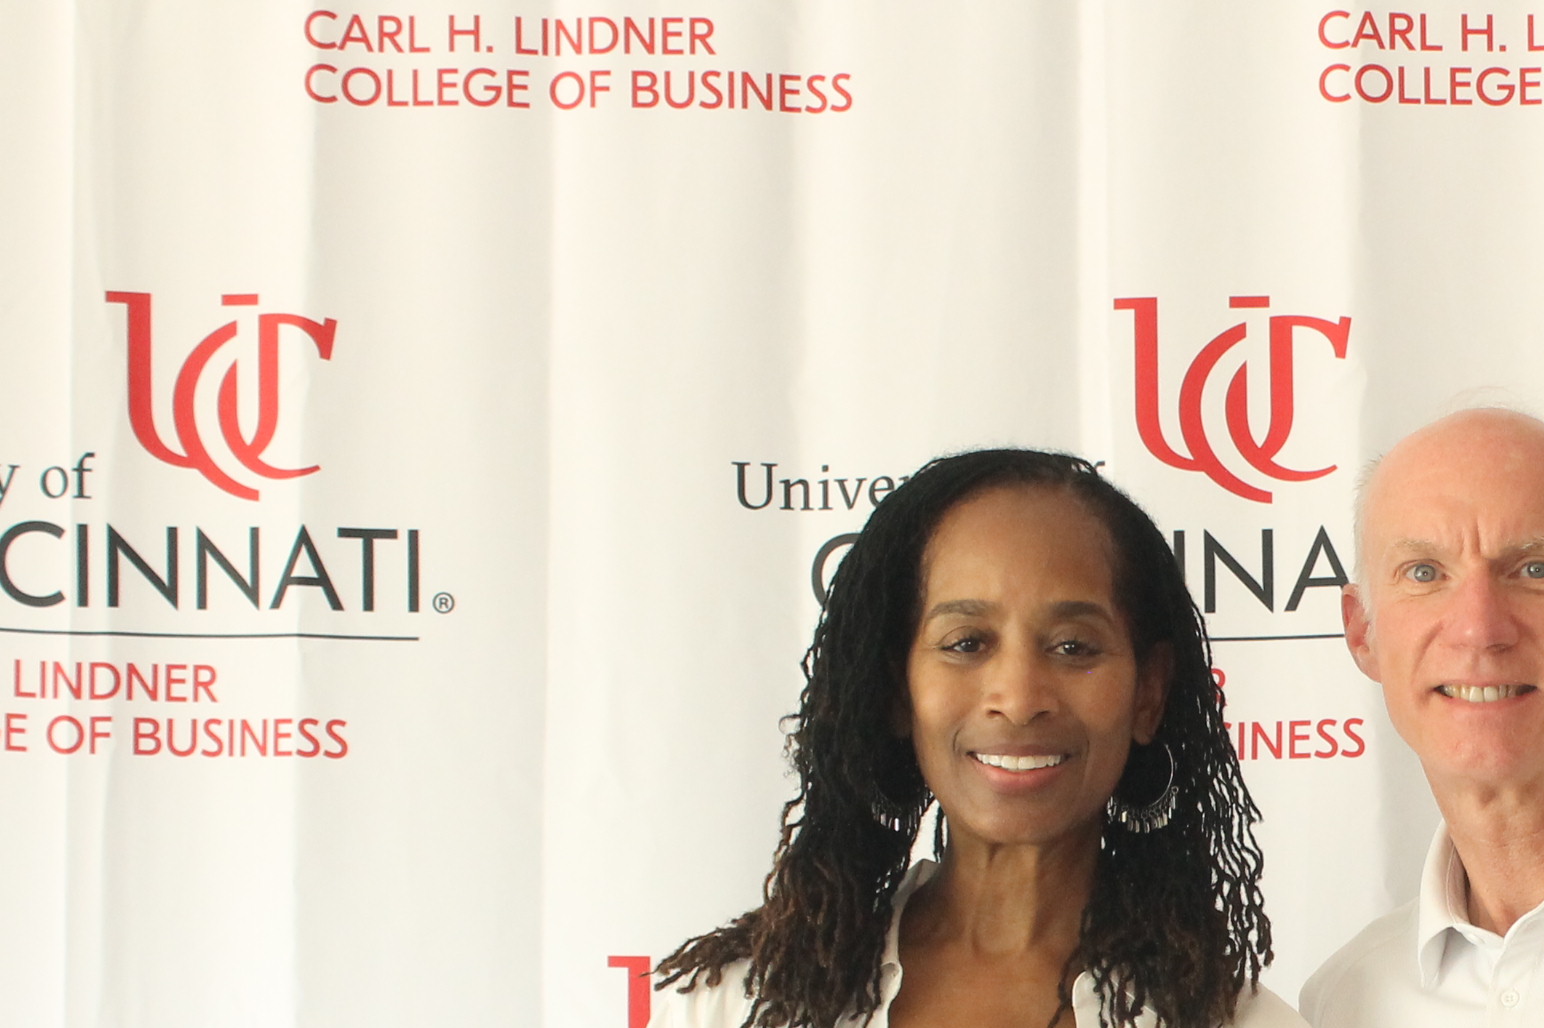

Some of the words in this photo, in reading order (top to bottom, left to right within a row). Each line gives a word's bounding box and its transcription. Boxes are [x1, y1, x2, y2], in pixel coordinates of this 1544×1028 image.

[305, 10, 431, 53] CARL
[449, 15, 494, 54] H.
[516, 16, 717, 57] LINDNER
[1318, 11, 1443, 52] CARL
[1461, 14, 1507, 53] H.
[305, 64, 532, 109] COLLEGE
[549, 70, 612, 110] OF
[630, 71, 854, 114] BUSINESS
[1318, 64, 1543, 107] COLLEGE
[40, 452, 95, 499] of
[15, 659, 218, 702] LINDNER
[47, 715, 113, 756] OF
[133, 717, 349, 760] BUSINESS
[1224, 717, 1367, 761] INESS
